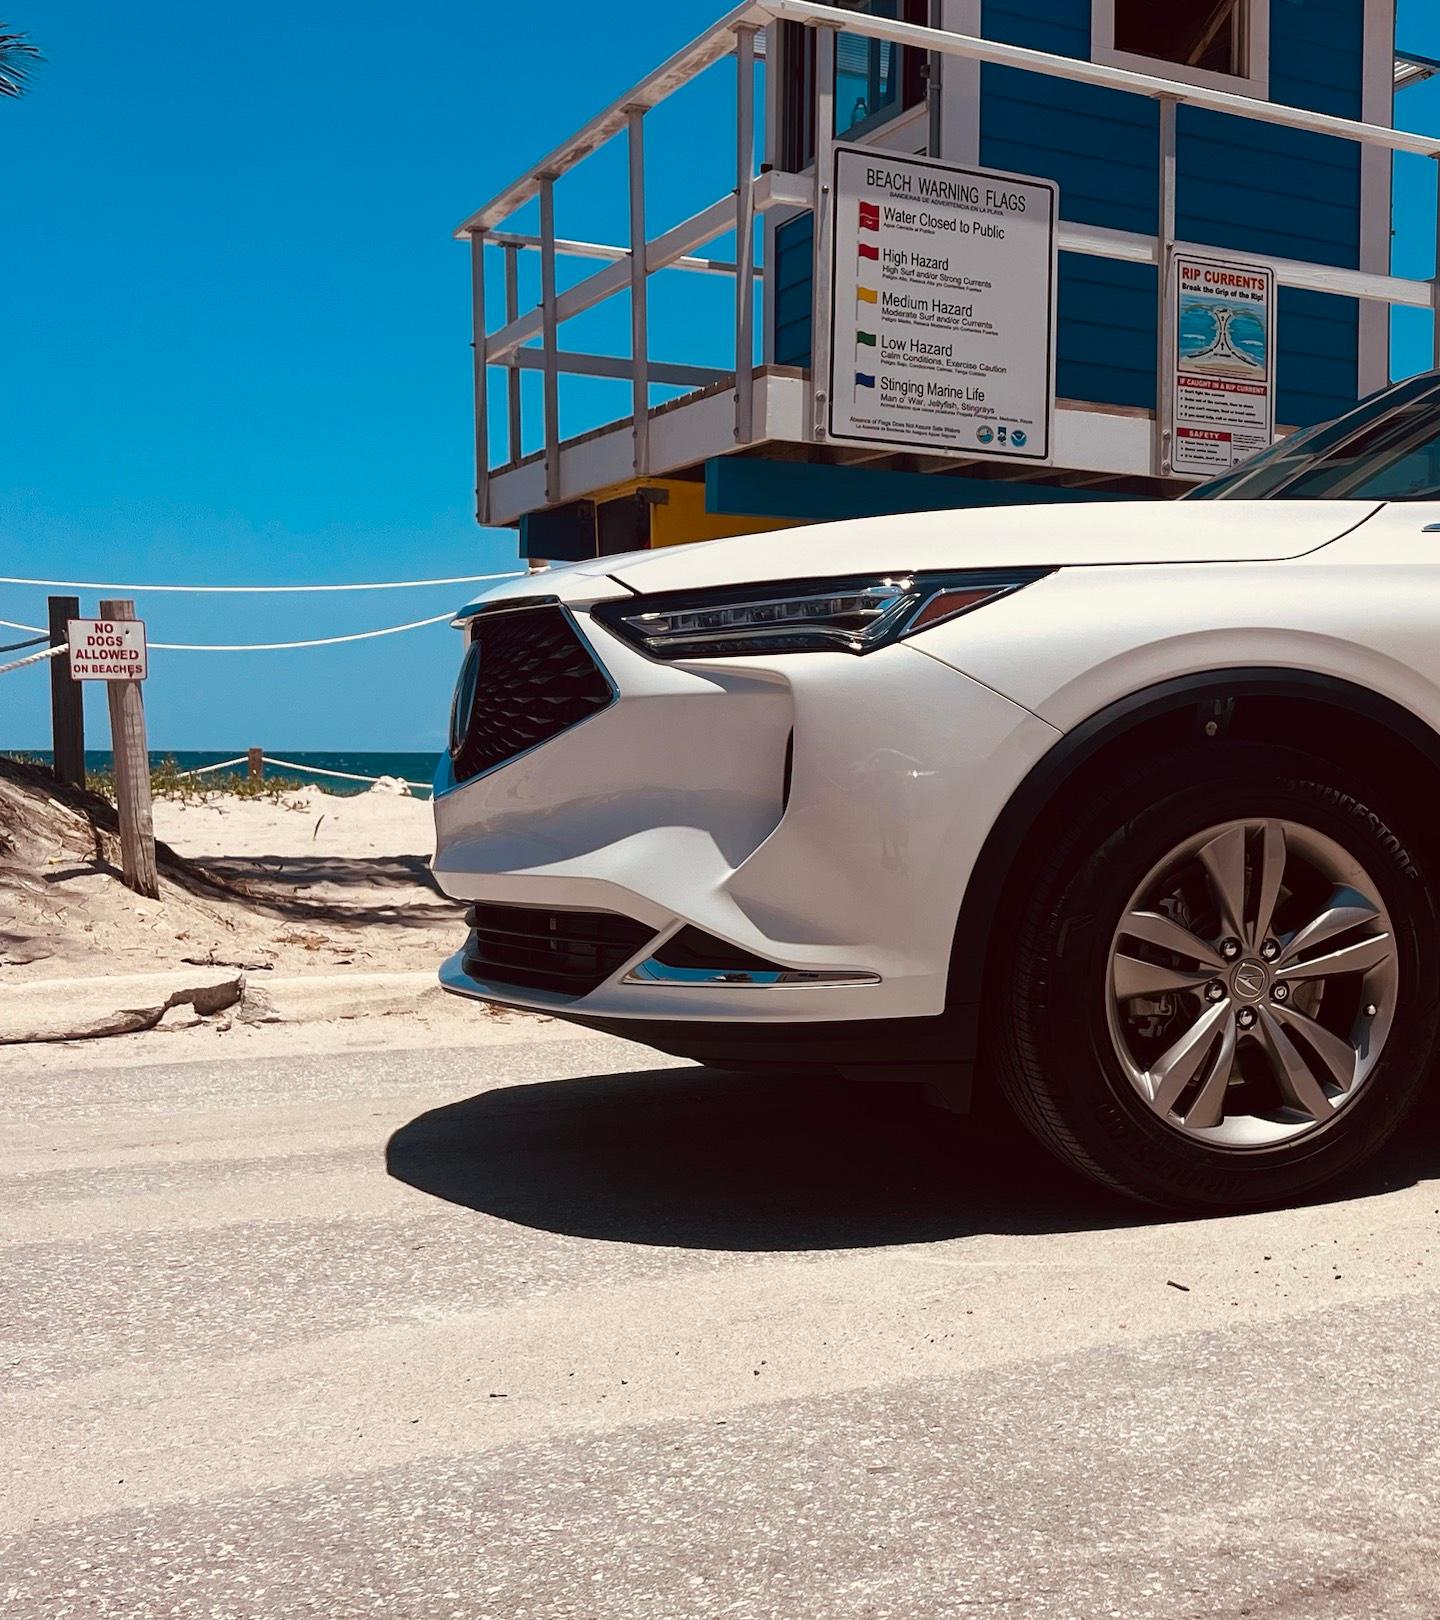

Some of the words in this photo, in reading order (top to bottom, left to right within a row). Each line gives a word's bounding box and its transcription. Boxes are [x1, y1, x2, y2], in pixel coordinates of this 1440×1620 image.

[866, 168, 912, 192] BEACH
[918, 177, 979, 204] WARNING
[986, 189, 1026, 212] FLAGS
[884, 206, 916, 225] Water
[919, 212, 957, 231] Closed
[960, 219, 970, 234] to
[973, 221, 1005, 239] Public
[883, 248, 907, 266] High
[911, 252, 949, 271] Hazard
[882, 265, 899, 275] High
[900, 267, 915, 276] Surf
[916, 271, 938, 280] and/or
[940, 273, 962, 285] Strong
[963, 277, 992, 288] Currents
[1182, 267, 1201, 280] RIP
[1204, 270, 1265, 291] CURRENTS
[1182, 282, 1201, 292] Break
[1203, 286, 1213, 294] the
[1215, 288, 1228, 297] Grip
[1238, 291, 1249, 299] the
[1251, 292, 1264, 302] Rip!
[882, 291, 928, 311] Medium
[932, 298, 973, 317] Hazard
[882, 307, 917, 319] Moderate
[919, 312, 935, 321] Surf
[936, 315, 960, 325] and/or
[961, 318, 993, 329] Currents
[881, 334, 907, 351] Low
[910, 338, 953, 357] Hazard
[880, 350, 901, 360] Calm
[946, 358, 977, 370] Exercise
[979, 363, 1007, 374] Caution
[880, 376, 924, 398] Stinging
[927, 382, 963, 399] Marine
[966, 386, 985, 401] Life
[1186, 379, 1211, 388] CAUGHT
[1236, 384, 1265, 394] CURRENT
[880, 393, 897, 403] Man
[907, 396, 926, 407] War,
[961, 402, 995, 416] Stingrays
[1189, 430, 1220, 440] SAFETY
[94, 623, 114, 634] NO
[87, 636, 123, 647] DOGS
[75, 649, 139, 660] ALLOWED
[73, 664, 89, 673] ON
[92, 664, 143, 673] BEACHES
